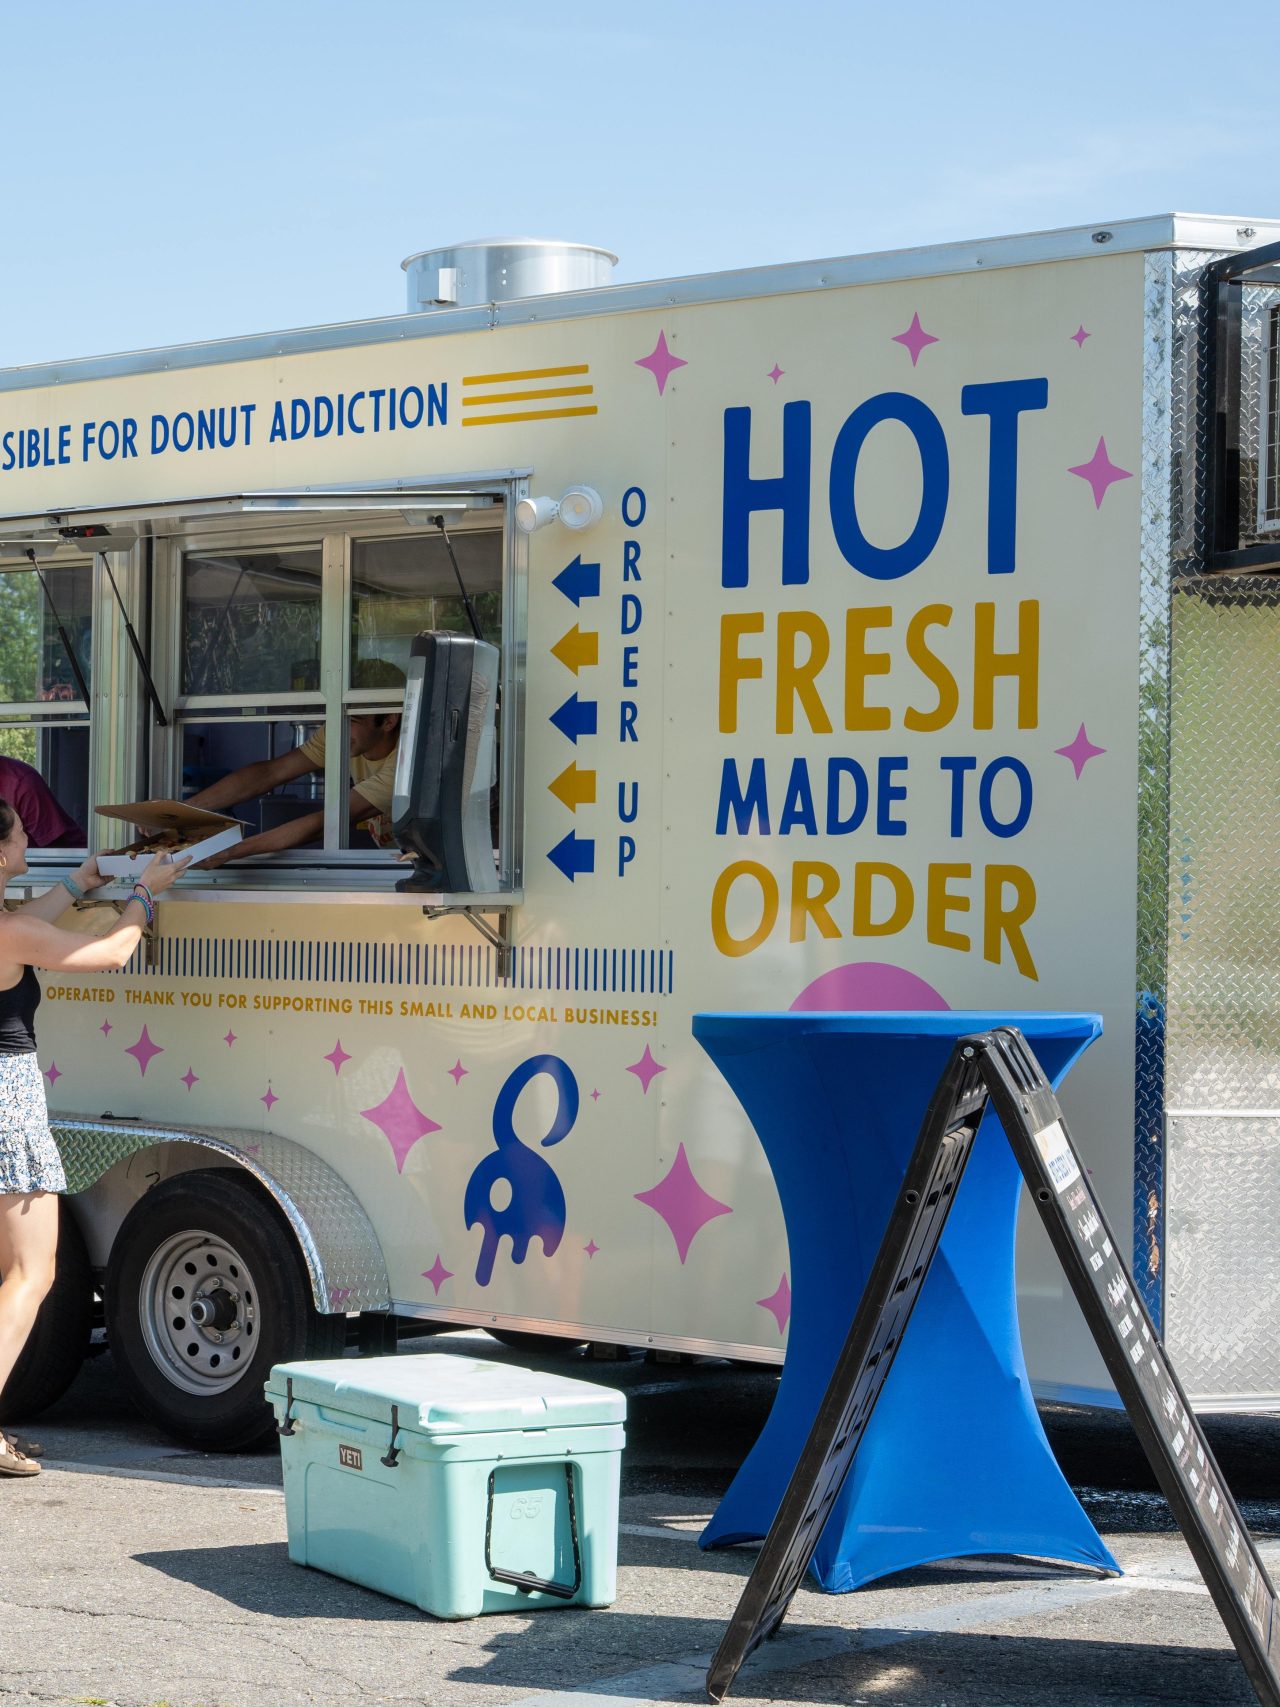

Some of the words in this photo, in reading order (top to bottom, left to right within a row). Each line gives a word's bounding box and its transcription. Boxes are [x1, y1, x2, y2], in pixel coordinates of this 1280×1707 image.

[82, 418, 139, 463] FOR
[150, 404, 257, 456] DONUT
[269, 382, 448, 443] ADDICTION
[722, 377, 1049, 588] HOT
[620, 486, 647, 742] ORDER
[719, 600, 1039, 735] FRESH
[618, 782, 639, 877] UP
[716, 756, 908, 836] MADE
[939, 755, 1033, 838] TO
[712, 859, 1038, 980] ORDER
[46, 986, 116, 1003] OPERATED
[124, 990, 175, 1006] THANK
[180, 992, 213, 1008] YOU
[218, 993, 248, 1009] FOR
[252, 994, 354, 1015] SUPPORTING
[359, 999, 394, 1016] THIS
[399, 1000, 453, 1020] SMALL
[459, 1003, 498, 1021] AND
[503, 1005, 558, 1023] LOCAL
[563, 1008, 658, 1027] BUSINESS!
[340, 1447, 361, 1467] YETI
[510, 1497, 543, 1520] 65
